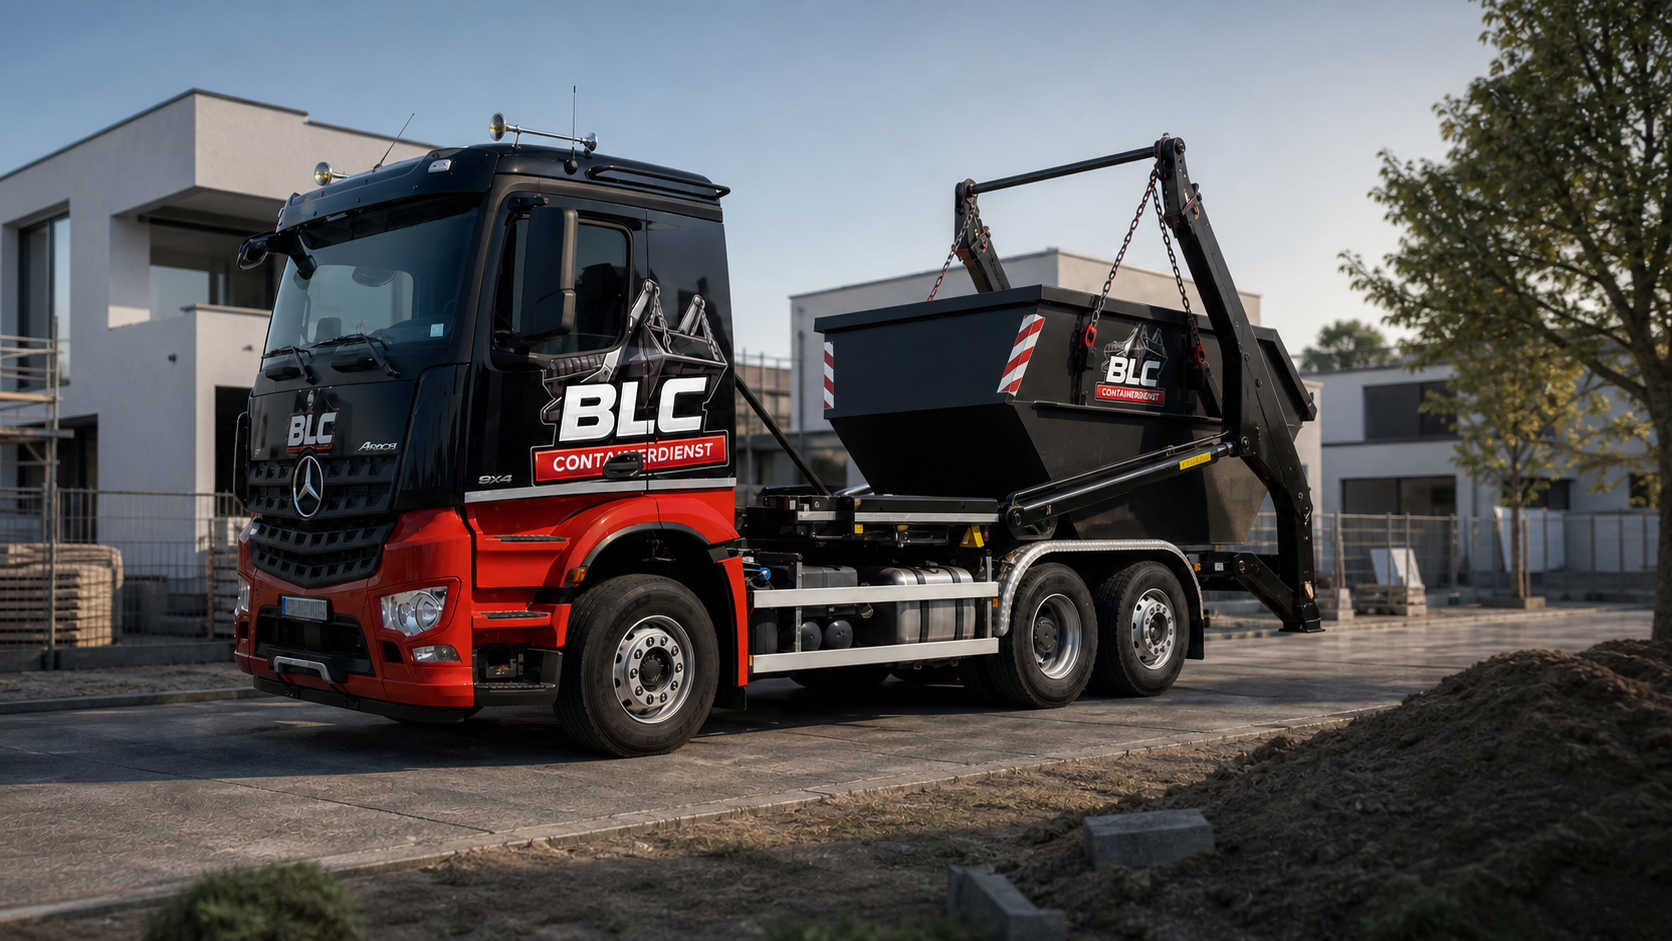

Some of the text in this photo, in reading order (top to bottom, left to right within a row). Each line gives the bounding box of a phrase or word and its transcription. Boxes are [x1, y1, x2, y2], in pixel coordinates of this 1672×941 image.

[1106, 356, 1161, 387] BLC
[559, 377, 707, 441] BLC
[287, 412, 337, 447] BLC
[553, 443, 713, 472] CONTAERDIENST
